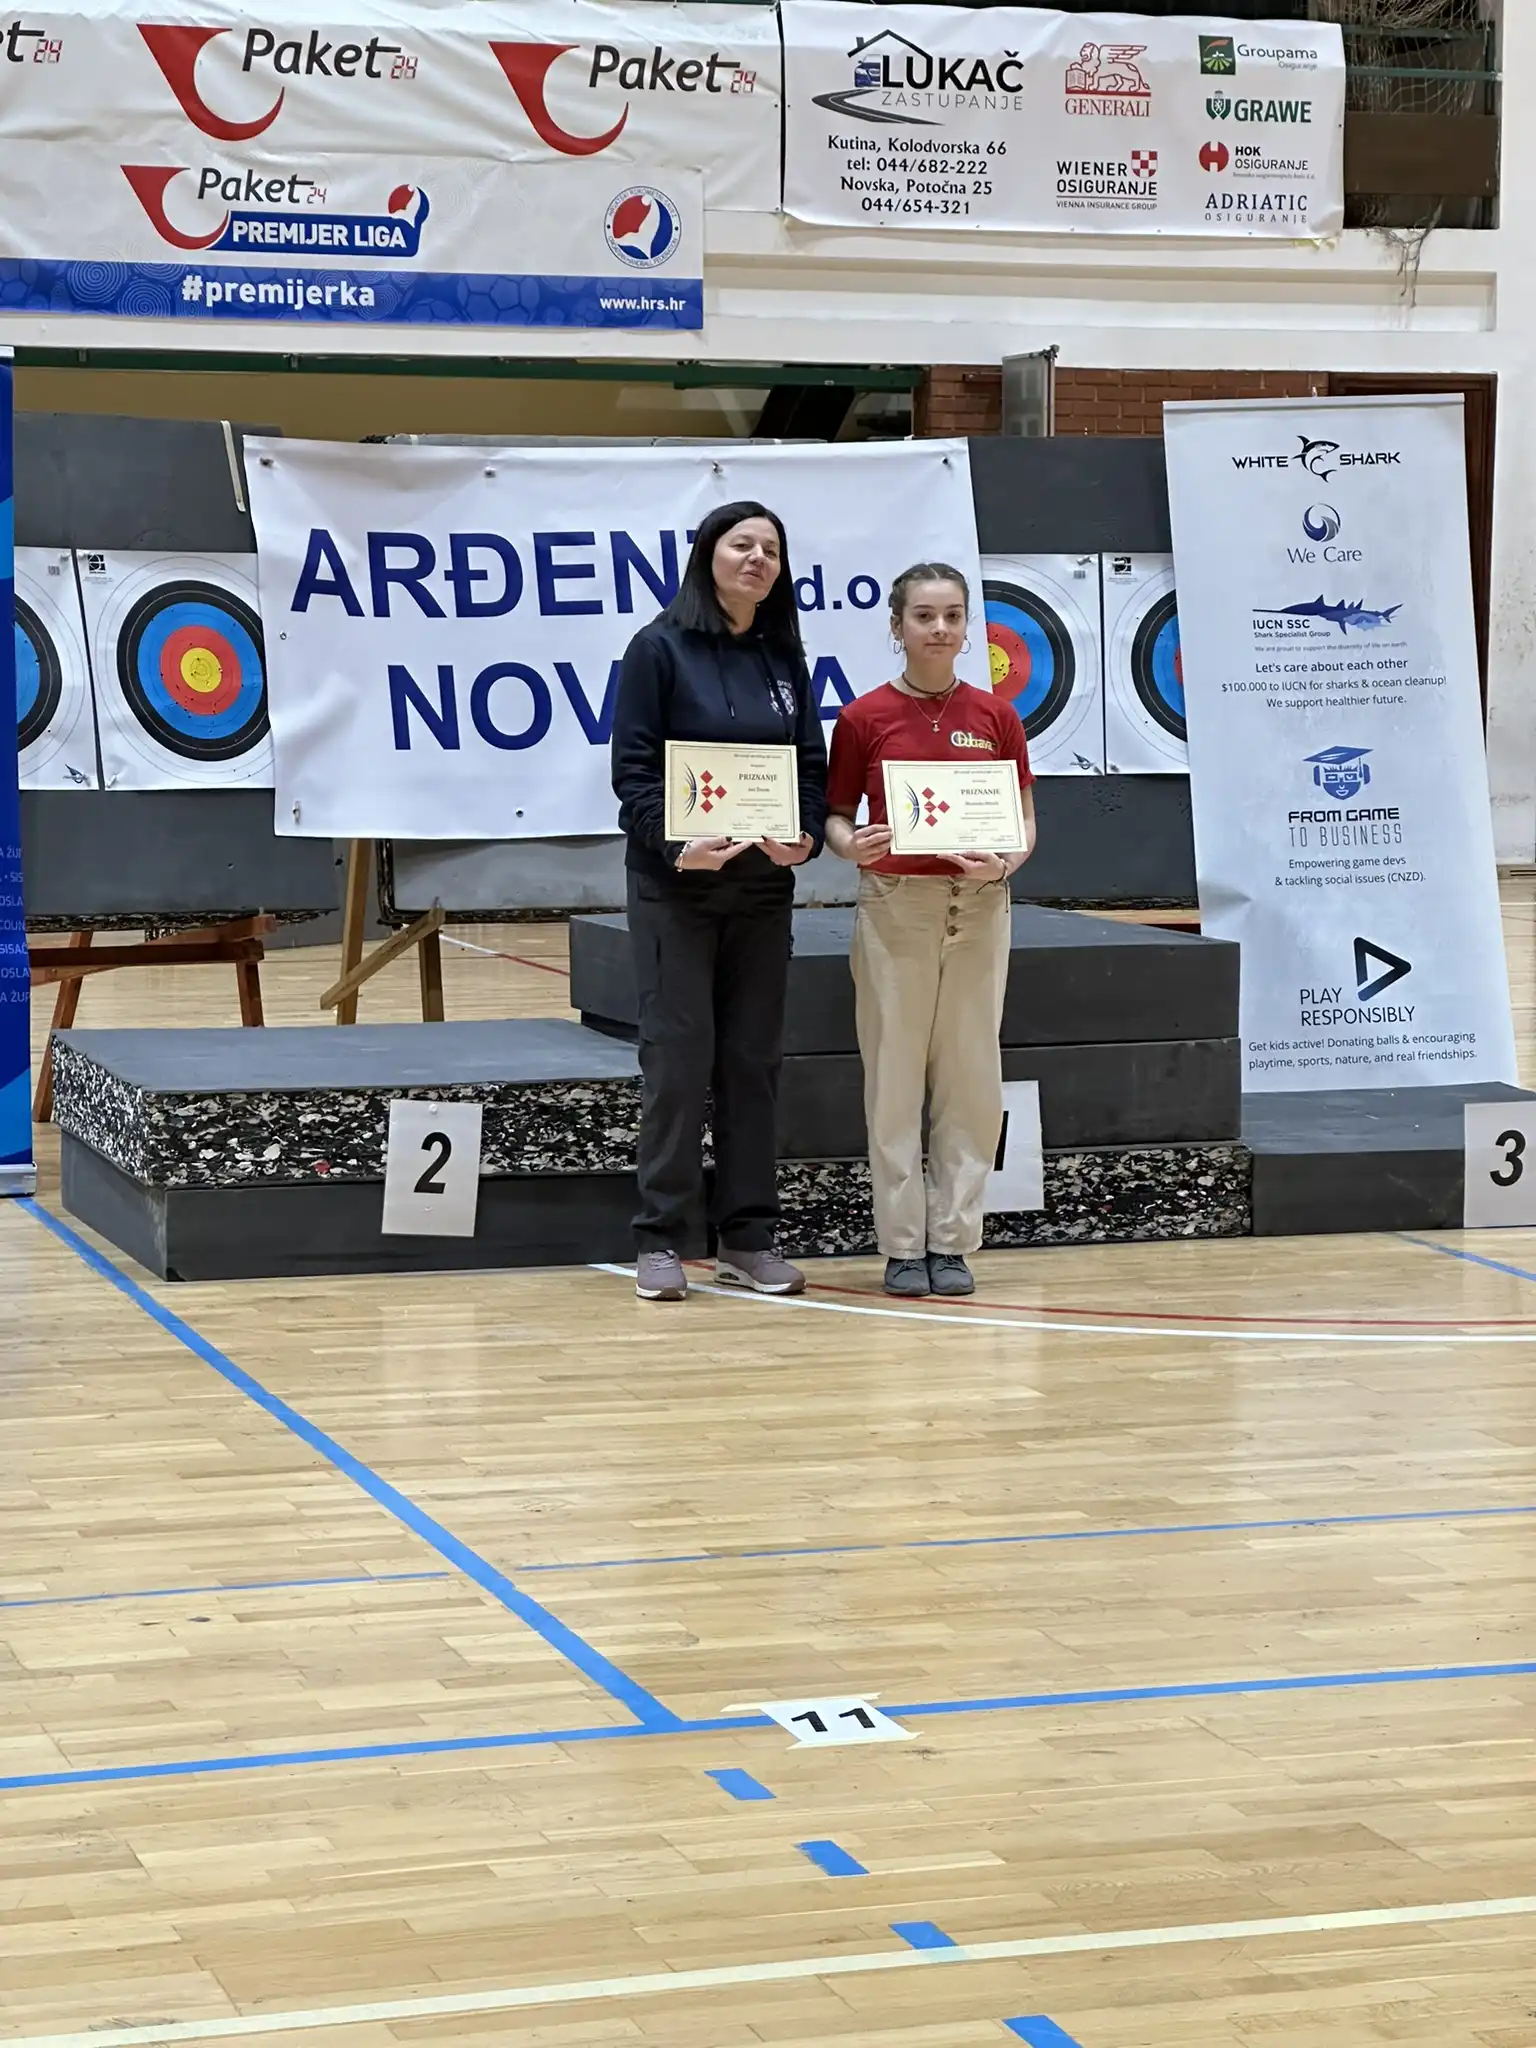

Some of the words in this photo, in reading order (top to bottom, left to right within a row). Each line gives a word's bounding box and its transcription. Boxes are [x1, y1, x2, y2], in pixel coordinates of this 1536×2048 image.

[242, 28, 401, 78] Paket
[1237, 44, 1318, 61] Groupama
[589, 44, 740, 93] Paket
[882, 50, 1024, 93] LUKAČ
[881, 91, 1023, 111] ZASTUPANJE
[1065, 98, 1151, 117] GENERALI
[1234, 99, 1312, 123] GRAWE
[828, 135, 881, 152] Kutina,
[888, 137, 980, 154] Kolodvorska
[986, 141, 1007, 155] 66
[1235, 146, 1261, 156] HOK
[847, 158, 871, 171] tel:
[877, 157, 988, 174] 044/682-222
[1057, 161, 1127, 177] WIENER
[1235, 159, 1308, 170] OSIGURANJE
[197, 167, 314, 203] Paket
[306, 187, 327, 204] 24
[841, 176, 900, 194] Novska,
[907, 179, 966, 195] Potočna
[973, 181, 993, 195] 25
[1057, 179, 1157, 195] OSIGURANJE
[861, 197, 970, 214] 044/654-321
[1087, 201, 1130, 210] INSURANCE
[1205, 193, 1308, 211] ADRIATIC
[1204, 212, 1307, 224] OSIGURANJE
[232, 220, 349, 247] PREMIJER
[354, 225, 407, 248] LIGA
[182, 275, 375, 310] #premijerka
[600, 297, 686, 311] www.hrs.hr
[1232, 455, 1289, 469] WHITE
[1340, 452, 1401, 466] SHARK
[1287, 548, 1316, 564] We
[1324, 547, 1362, 563] Care
[290, 528, 697, 618] ARĐEN
[1253, 619, 1282, 630] IUCN
[1286, 619, 1310, 630] SSC
[1254, 631, 1273, 639] Shark
[1275, 631, 1307, 639] Specialist
[1310, 630, 1331, 639] Group
[1256, 662, 1281, 673] Let's
[1284, 664, 1308, 672] care
[1311, 661, 1344, 672] about
[1347, 660, 1373, 671] each
[1377, 658, 1408, 669] other
[1221, 682, 1267, 692] $100.000
[1269, 682, 1279, 691] to
[1282, 681, 1306, 691] IUCN
[1309, 680, 1322, 690] for
[1326, 679, 1359, 690] sharks
[1361, 679, 1369, 688] &
[1372, 678, 1402, 688] ocean
[1404, 676, 1446, 687] cleanup!
[1266, 698, 1283, 707] We
[1285, 698, 1323, 710] support
[1326, 696, 1370, 706] healthier
[1373, 694, 1407, 704] future.
[738, 773, 777, 782] PRIZNANJE
[960, 788, 1001, 796] PRIZNANJE
[1288, 810, 1342, 823] FROM
[1346, 807, 1400, 821] GAME
[1289, 826, 1308, 847] TO
[1320, 823, 1402, 847] BUSINESS
[1289, 857, 1350, 870] Empowering
[1352, 857, 1380, 869] game
[1383, 855, 1406, 866] devs
[1275, 876, 1283, 886] &
[1285, 874, 1323, 887] tackling
[1325, 873, 1352, 885] social
[1355, 872, 1386, 883] issues
[1388, 871, 1426, 883] (CNZD).
[1300, 987, 1342, 1005] PLAY
[1301, 1006, 1415, 1026] RESPONSIBLY
[1249, 1041, 1267, 1051] Get
[1270, 1040, 1290, 1050] kids
[1292, 1039, 1324, 1049] active!
[1327, 1037, 1374, 1048] Donating
[1377, 1035, 1400, 1045] balls
[1402, 1035, 1410, 1044] &
[1412, 1032, 1476, 1044] encouraging
[1249, 1057, 1295, 1071] playtime,
[1298, 1057, 1332, 1068] sports,
[1335, 1055, 1371, 1065] nature,
[1374, 1052, 1393, 1062] and
[1396, 1051, 1415, 1061] real
[1418, 1048, 1477, 1060] friendships.
[413, 1132, 452, 1194] 2
[1490, 1130, 1526, 1187] 3
[791, 1707, 875, 1732] 11
